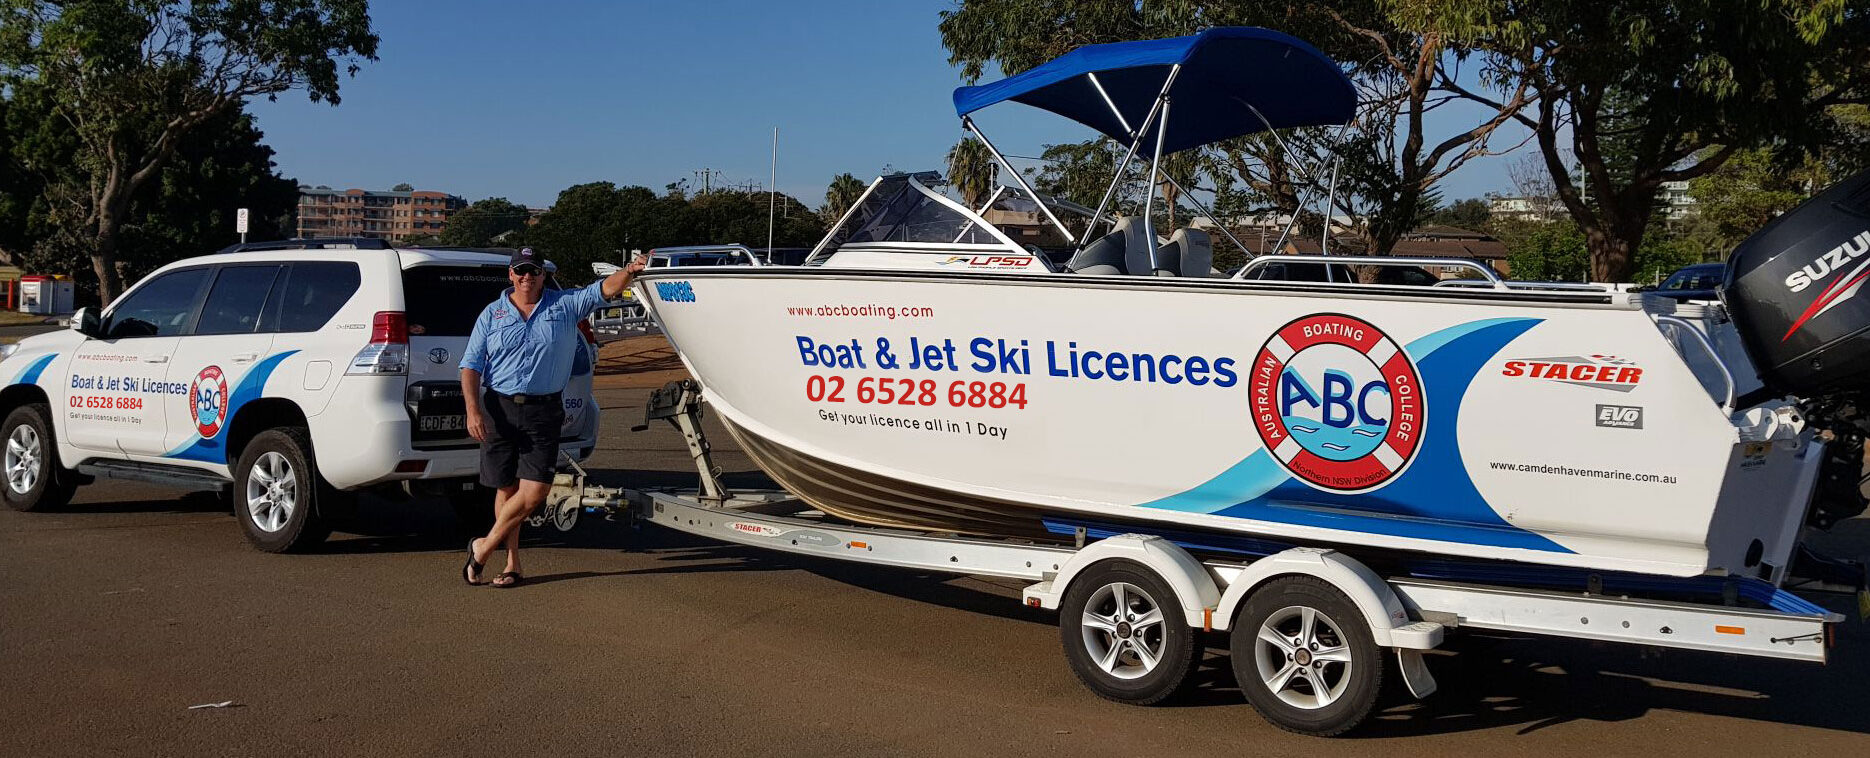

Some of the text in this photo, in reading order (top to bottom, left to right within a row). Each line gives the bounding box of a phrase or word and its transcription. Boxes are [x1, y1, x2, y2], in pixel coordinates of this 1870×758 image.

[970, 256, 1033, 266] LPSD
[787, 304, 934, 320] www.abcboating.com
[1303, 323, 1364, 341] BOATING
[796, 336, 1238, 388] Boat & Jet Ski Licences
[1502, 361, 1643, 383] STACER
[71, 374, 188, 395] Boat & Jet Ski Licences
[806, 375, 1028, 410] 02 6528 6884
[69, 396, 143, 410] 02 6528 6884
[197, 389, 220, 412] ABC
[1258, 355, 1281, 440] AUSTRALIAN
[1281, 366, 1390, 428] ABC
[1395, 374, 1415, 442] COLLEGE
[818, 409, 1008, 440] Get your licence all in 1 Day
[1599, 406, 1640, 422] EVO
[1293, 461, 1387, 486] Northern NSW Division
[1490, 461, 1678, 484] www.camdenhavenmarine.com.au
